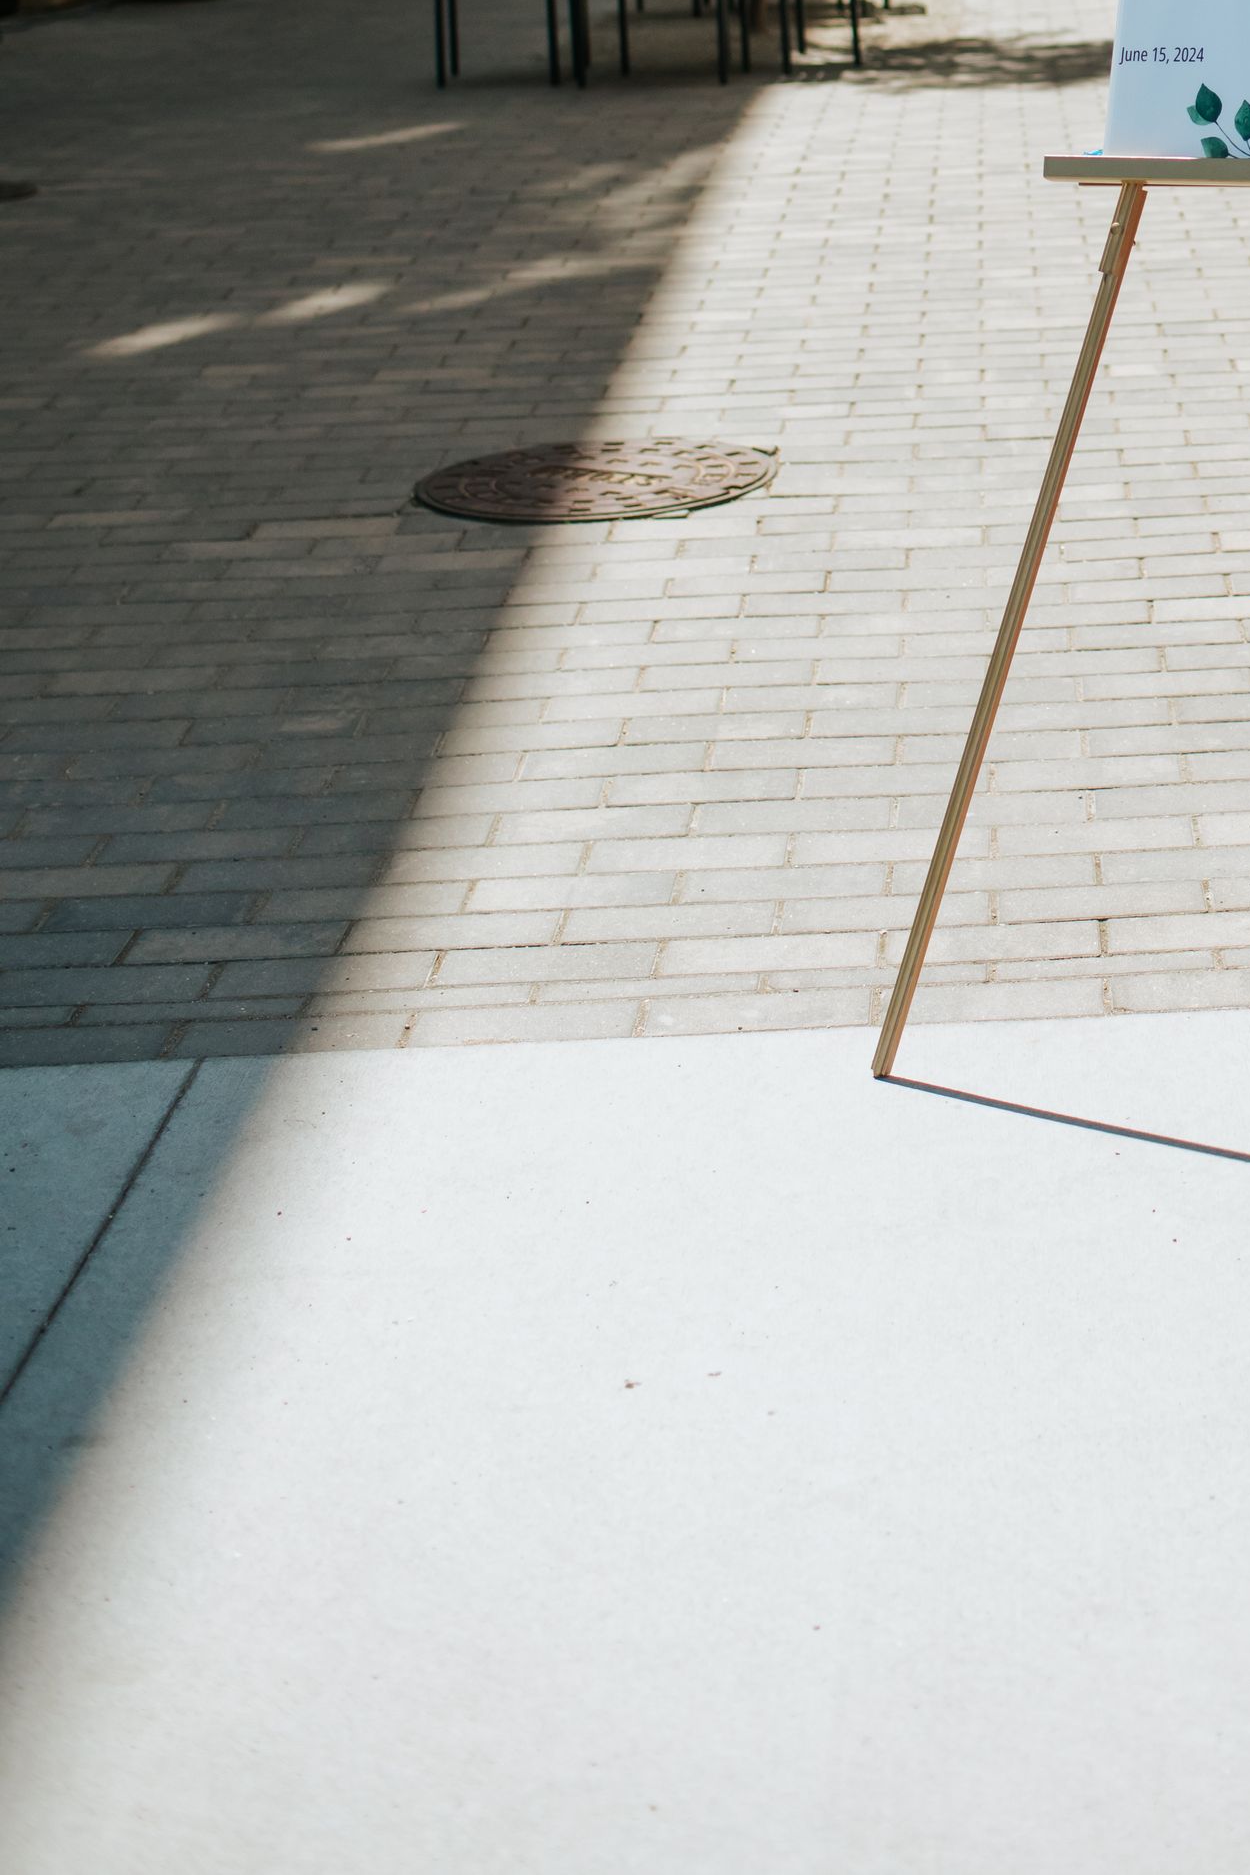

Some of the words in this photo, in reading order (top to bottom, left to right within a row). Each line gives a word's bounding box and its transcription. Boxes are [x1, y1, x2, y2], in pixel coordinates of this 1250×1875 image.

[1118, 46, 1148, 66] June
[1152, 46, 1170, 65] 15,
[1172, 46, 1205, 63] 2024
